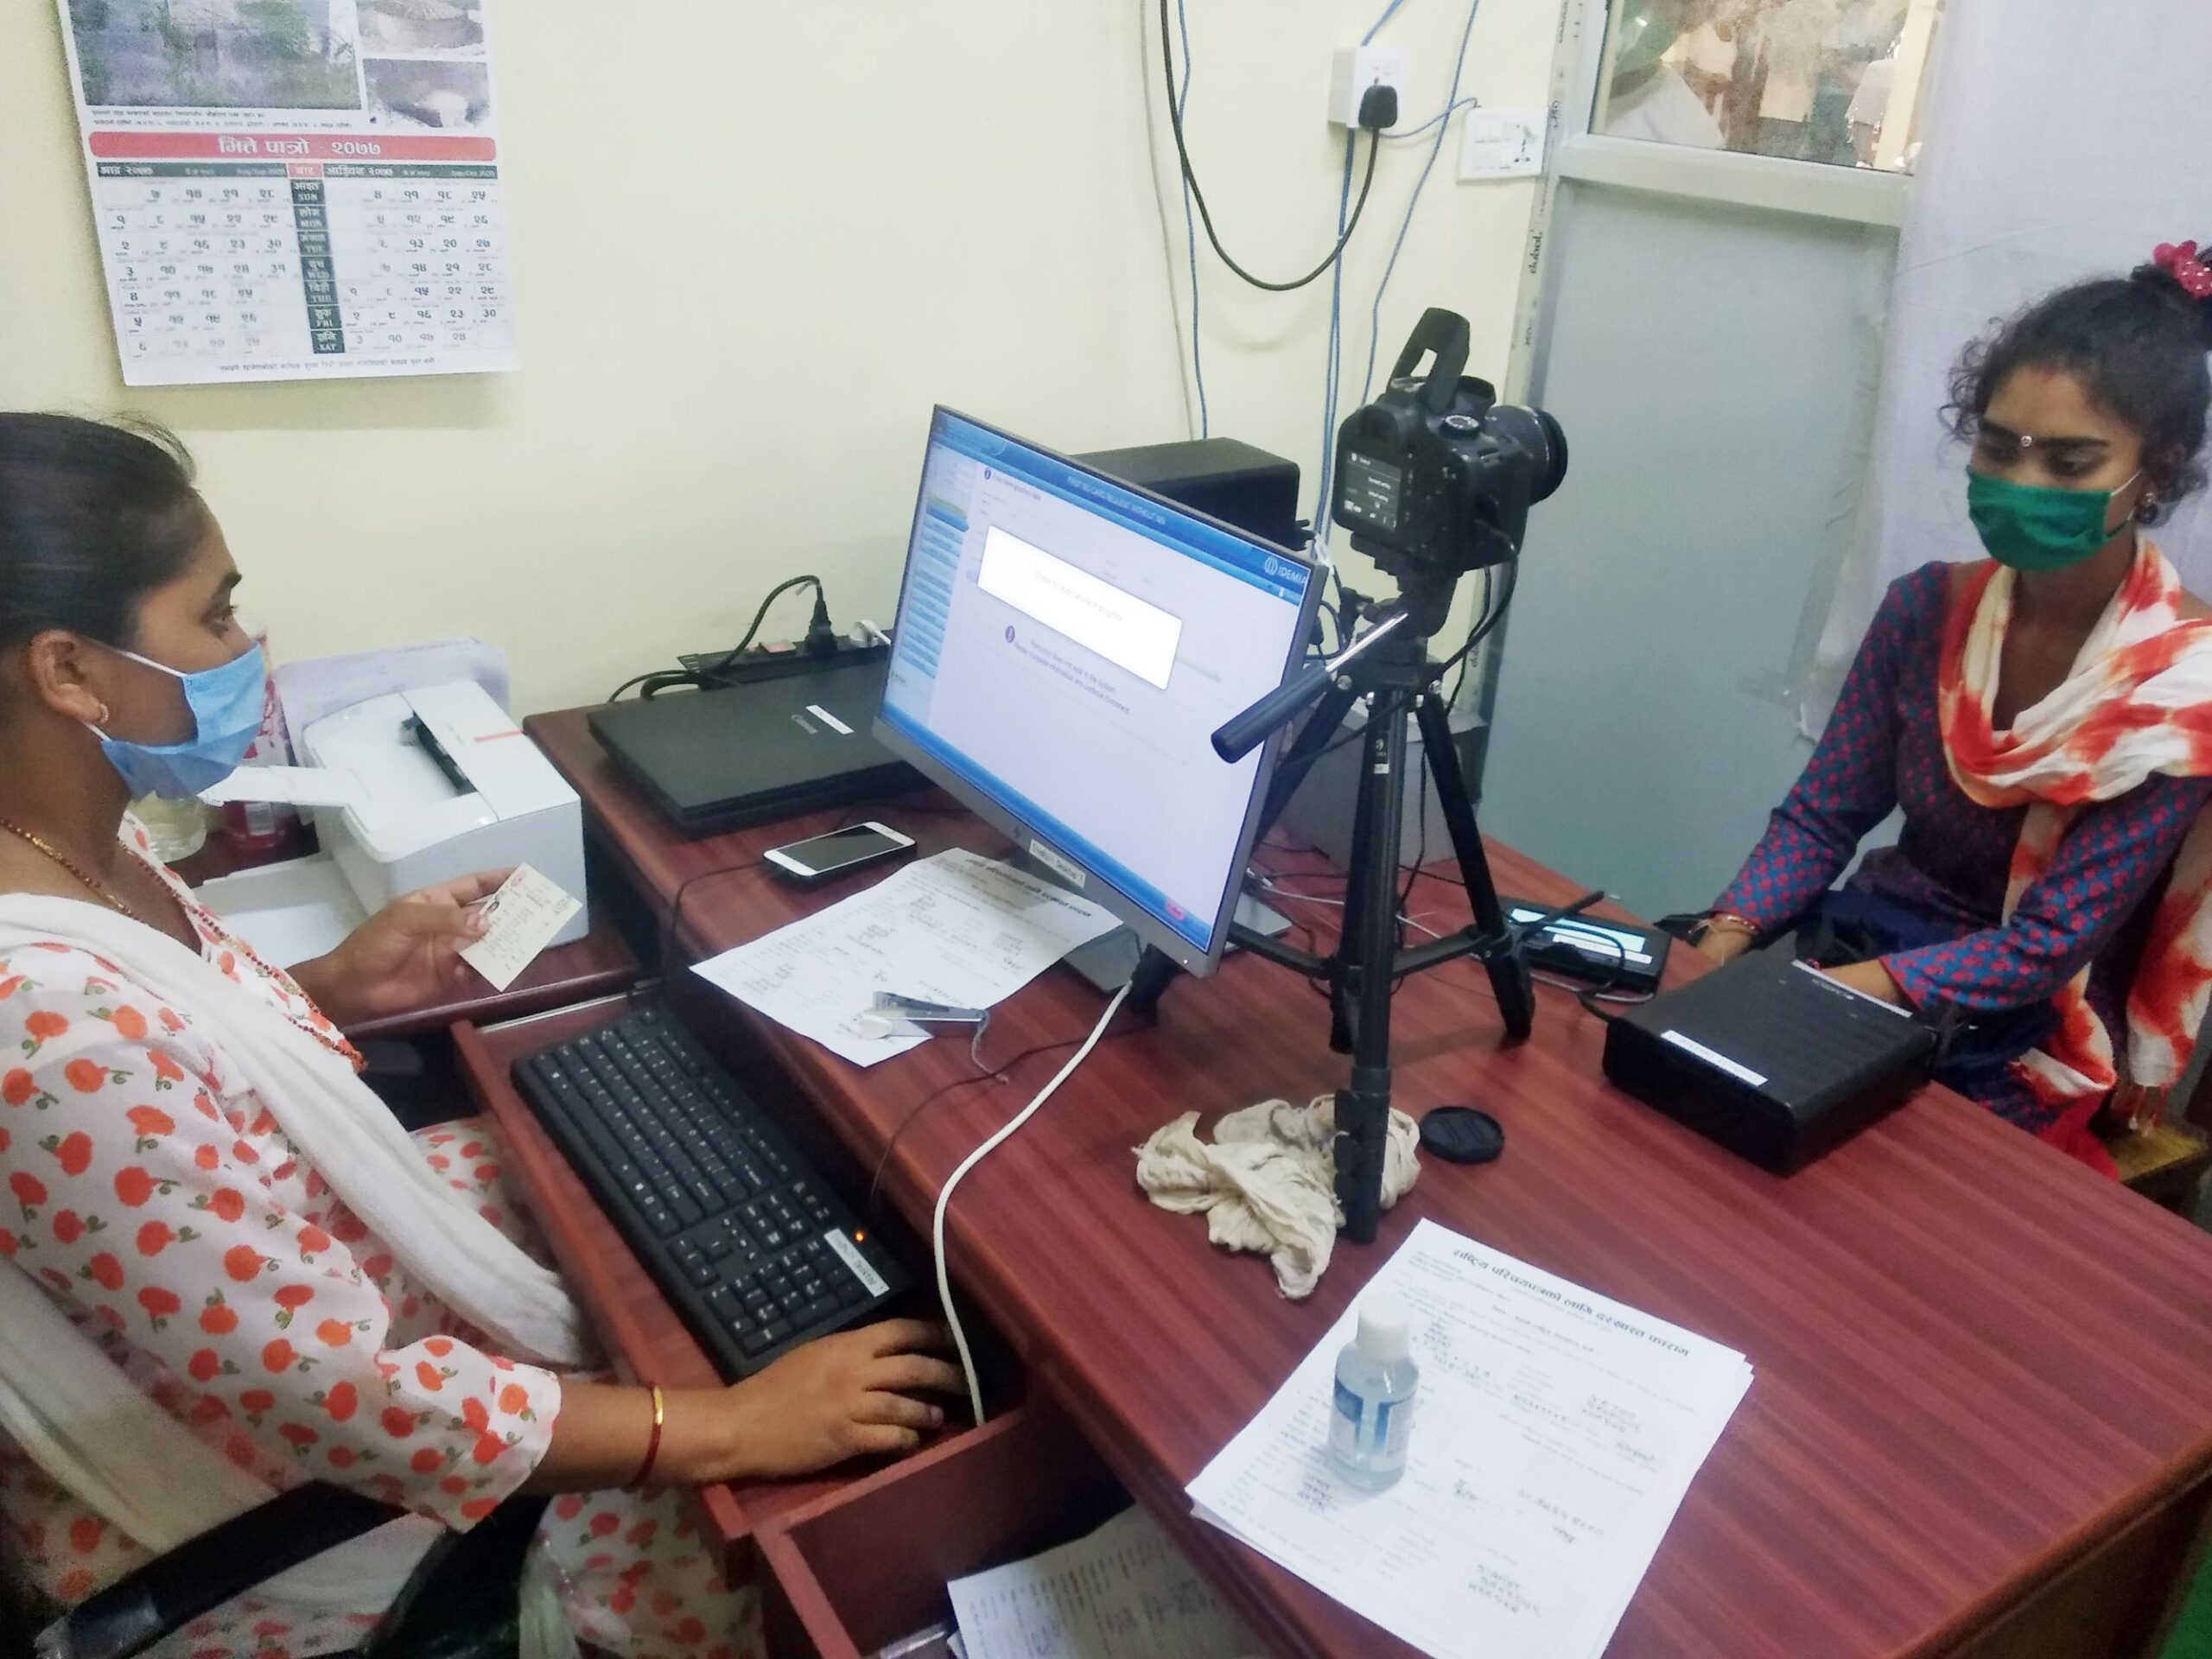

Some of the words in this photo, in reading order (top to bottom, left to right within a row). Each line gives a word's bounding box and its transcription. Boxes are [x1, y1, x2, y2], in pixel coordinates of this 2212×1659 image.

[264, 137, 309, 154] पात्रो
[331, 142, 381, 155] २०७७
[186, 189, 202, 199] १४
[223, 189, 238, 199] २१
[259, 189, 275, 198] २८
[472, 191, 486, 200] २५
[118, 215, 124, 224] १
[190, 215, 205, 224] १५
[474, 215, 488, 224] २६
[122, 241, 130, 250] २
[194, 240, 210, 249] १६
[231, 240, 245, 249] २३
[267, 239, 282, 248] ३०
[410, 239, 424, 248] १३
[126, 267, 133, 276] ३
[161, 266, 175, 275] १०
[270, 264, 285, 273] ३१
[479, 263, 492, 271] २८
[164, 291, 180, 300] ११
[238, 289, 252, 298] २५
[351, 288, 357, 296] १
[415, 287, 429, 296] १५
[481, 286, 494, 295] २९
[417, 310, 431, 320] १६
[450, 310, 463, 319] २३
[1278, 565, 1308, 586] IDEMIA
[1563, 1292, 1594, 1314] लागि
